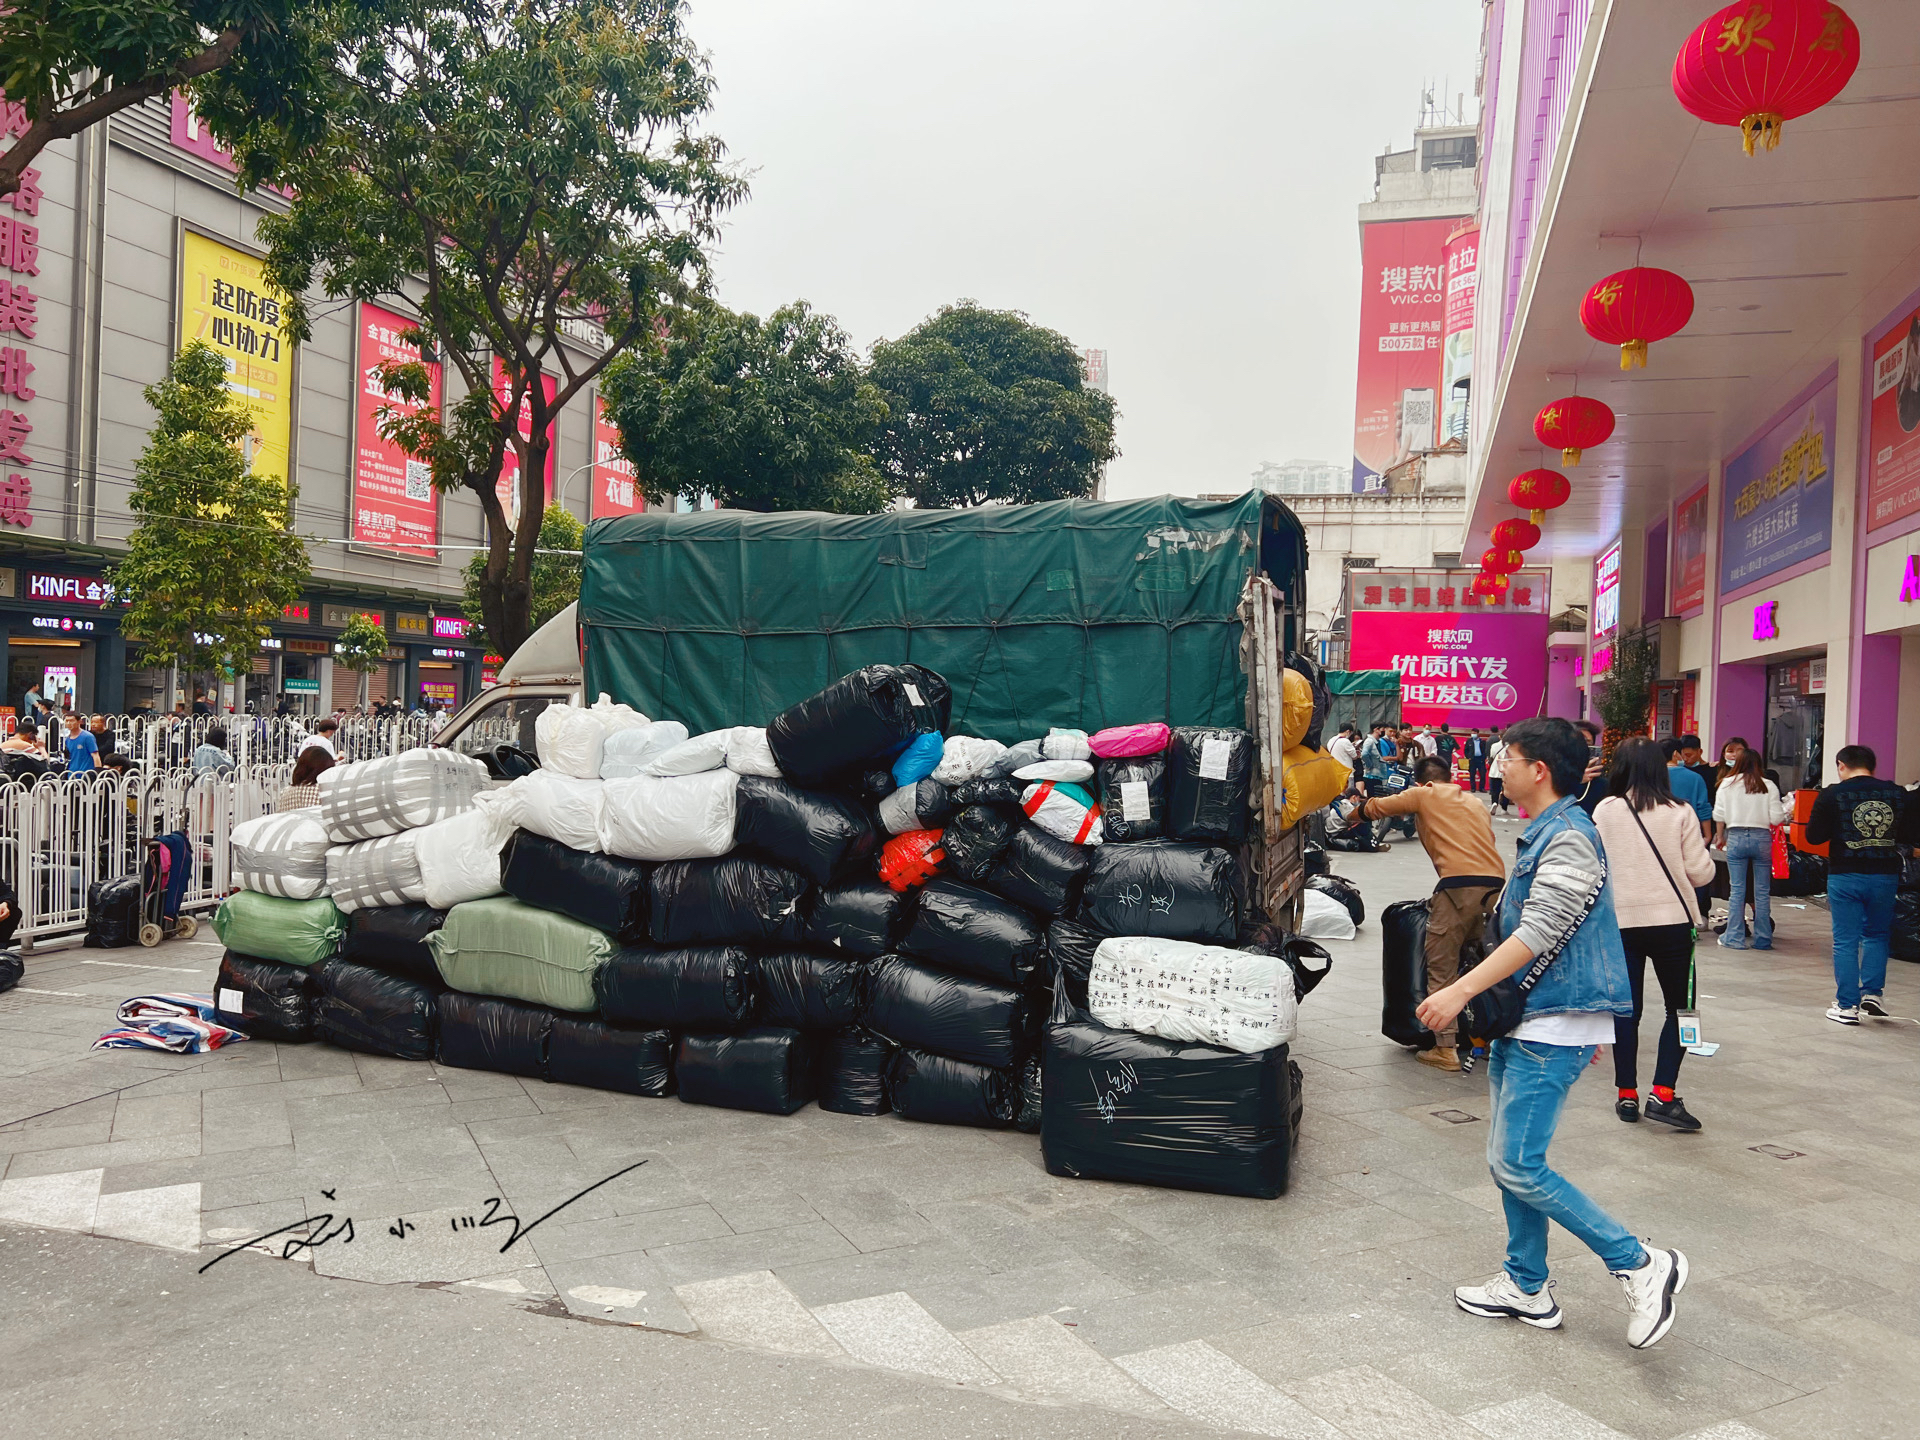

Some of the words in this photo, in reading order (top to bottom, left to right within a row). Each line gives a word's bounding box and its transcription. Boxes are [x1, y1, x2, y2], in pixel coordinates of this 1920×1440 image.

[1426, 336, 1440, 349] 任
[31, 575, 85, 599] KINFL
[32, 617, 59, 628] GATE
[1427, 629, 1473, 644] 搜款网
[1391, 654, 1508, 679] 优质代发
